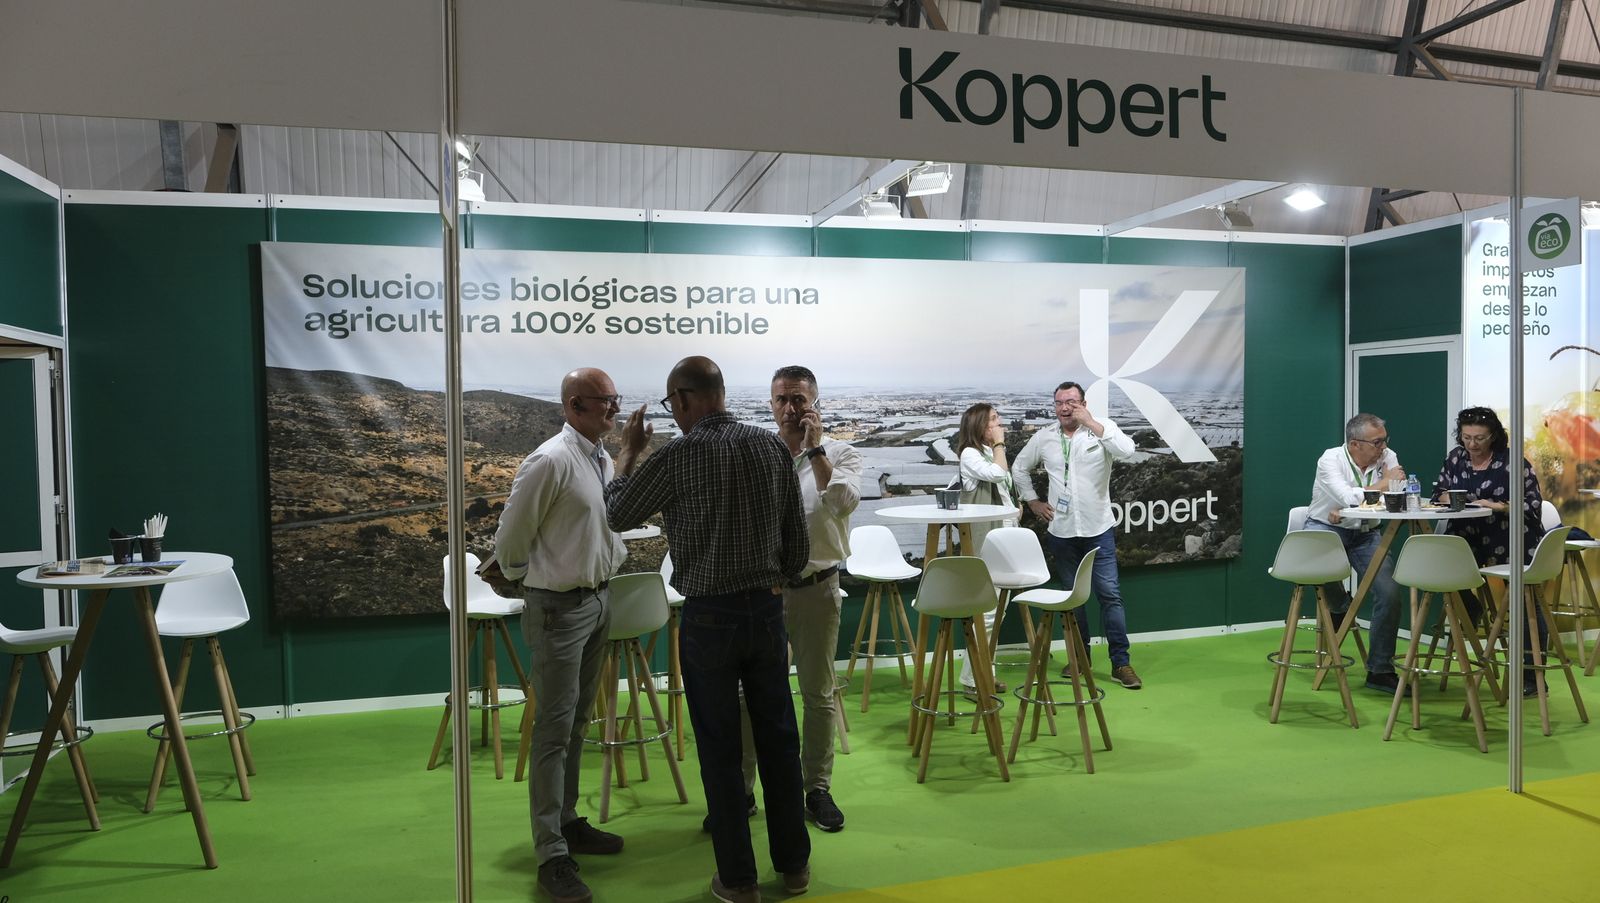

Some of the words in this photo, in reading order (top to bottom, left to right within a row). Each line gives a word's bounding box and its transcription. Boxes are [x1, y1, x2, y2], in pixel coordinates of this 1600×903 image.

[898, 47, 1227, 147] Koppert
[1541, 238, 1558, 248] eco
[302, 273, 500, 301] Solucioes
[511, 276, 677, 310] biológicas
[686, 285, 756, 309] para
[765, 286, 819, 305] una
[1482, 301, 1530, 316] dese
[1535, 302, 1547, 316] lo
[304, 305, 500, 339] agricultra
[511, 311, 596, 334] 100%
[604, 310, 769, 335] sostenible
[1482, 320, 1551, 338] peeño
[1110, 490, 1219, 533] oppert
